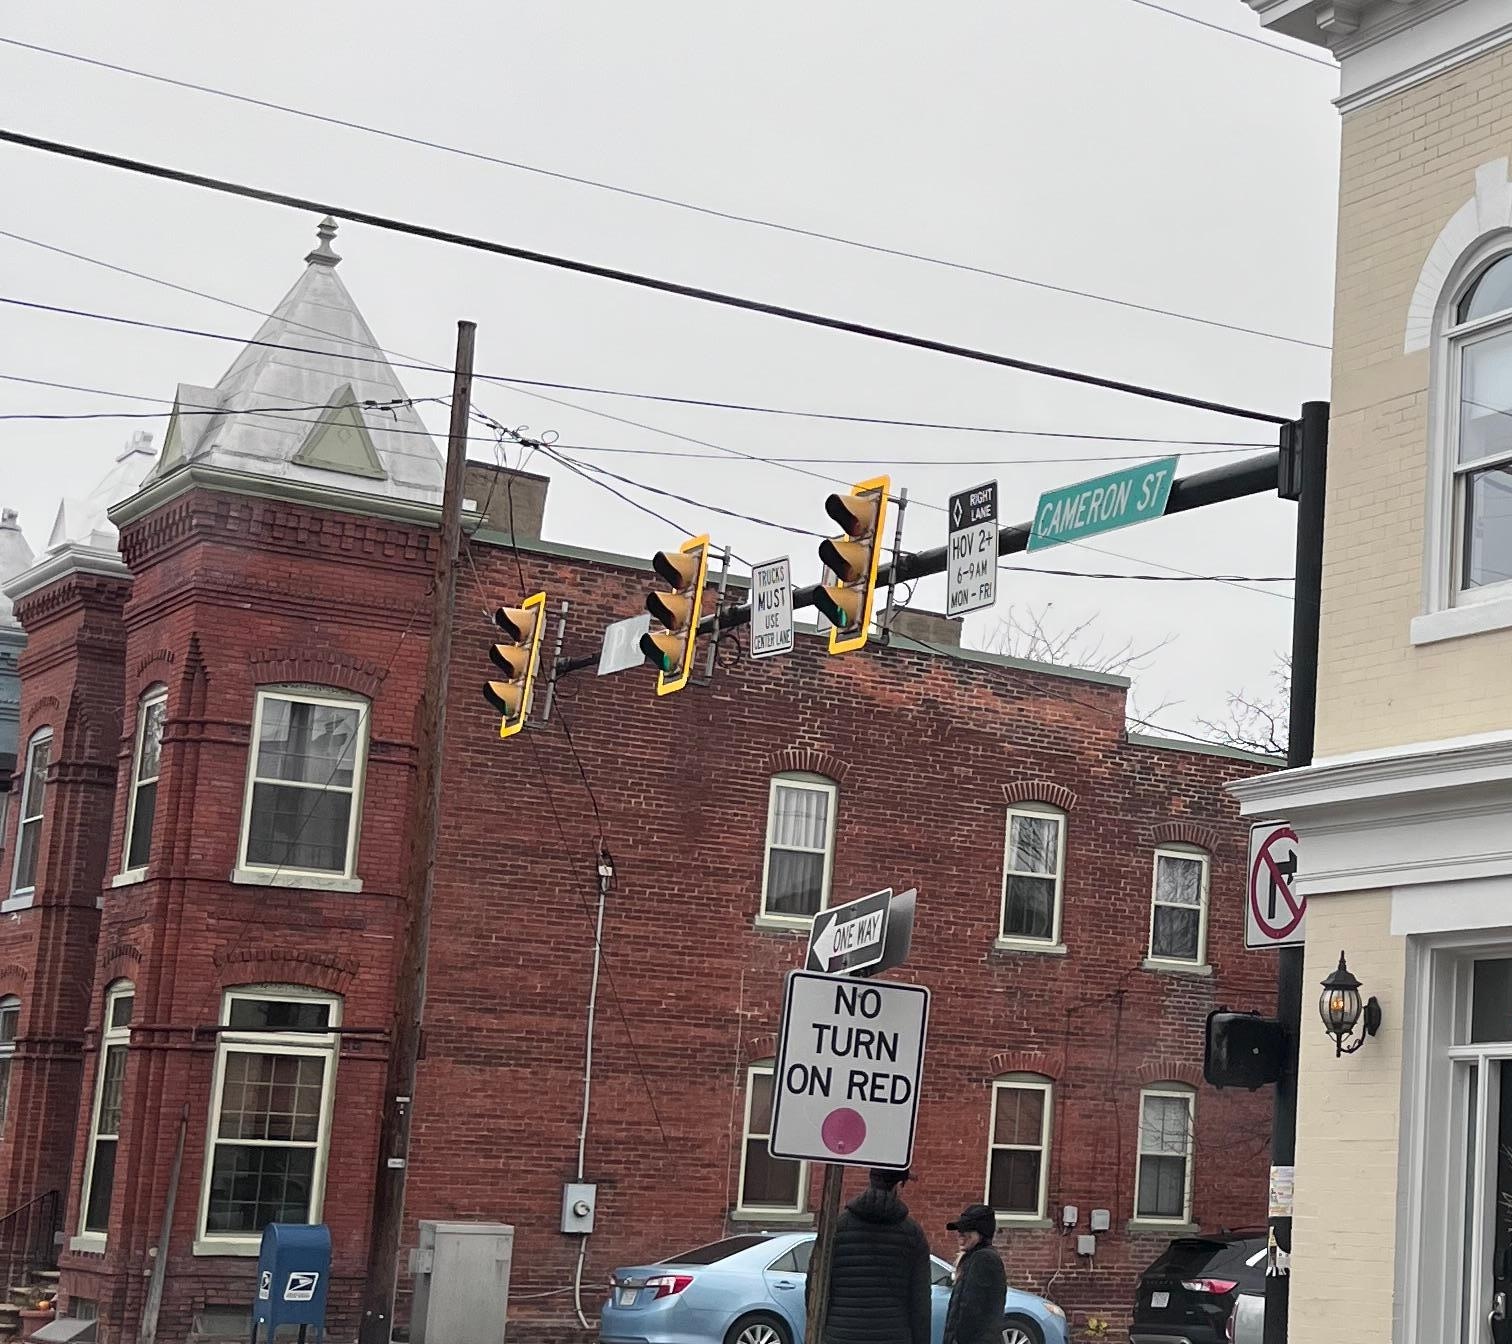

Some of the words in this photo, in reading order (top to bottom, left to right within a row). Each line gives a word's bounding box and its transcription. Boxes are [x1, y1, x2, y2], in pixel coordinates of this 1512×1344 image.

[969, 488, 993, 506] RIGHT
[1038, 479, 1133, 539] CAMERON
[1136, 470, 1167, 512] ST
[971, 505, 992, 522] LANE
[952, 532, 974, 561] HOV
[978, 529, 993, 553] 2+
[758, 565, 785, 587] TRUCKS
[758, 587, 786, 612] MUST
[951, 588, 969, 609] MON
[978, 581, 992, 602] FRI
[765, 612, 780, 630] USE
[776, 628, 791, 647] LANE
[832, 922, 854, 953] ONE
[856, 913, 880, 947] WAY
[834, 984, 881, 1019] NO
[812, 1023, 899, 1063] TURN
[786, 1063, 833, 1097] ON
[846, 1069, 912, 1106] RED
